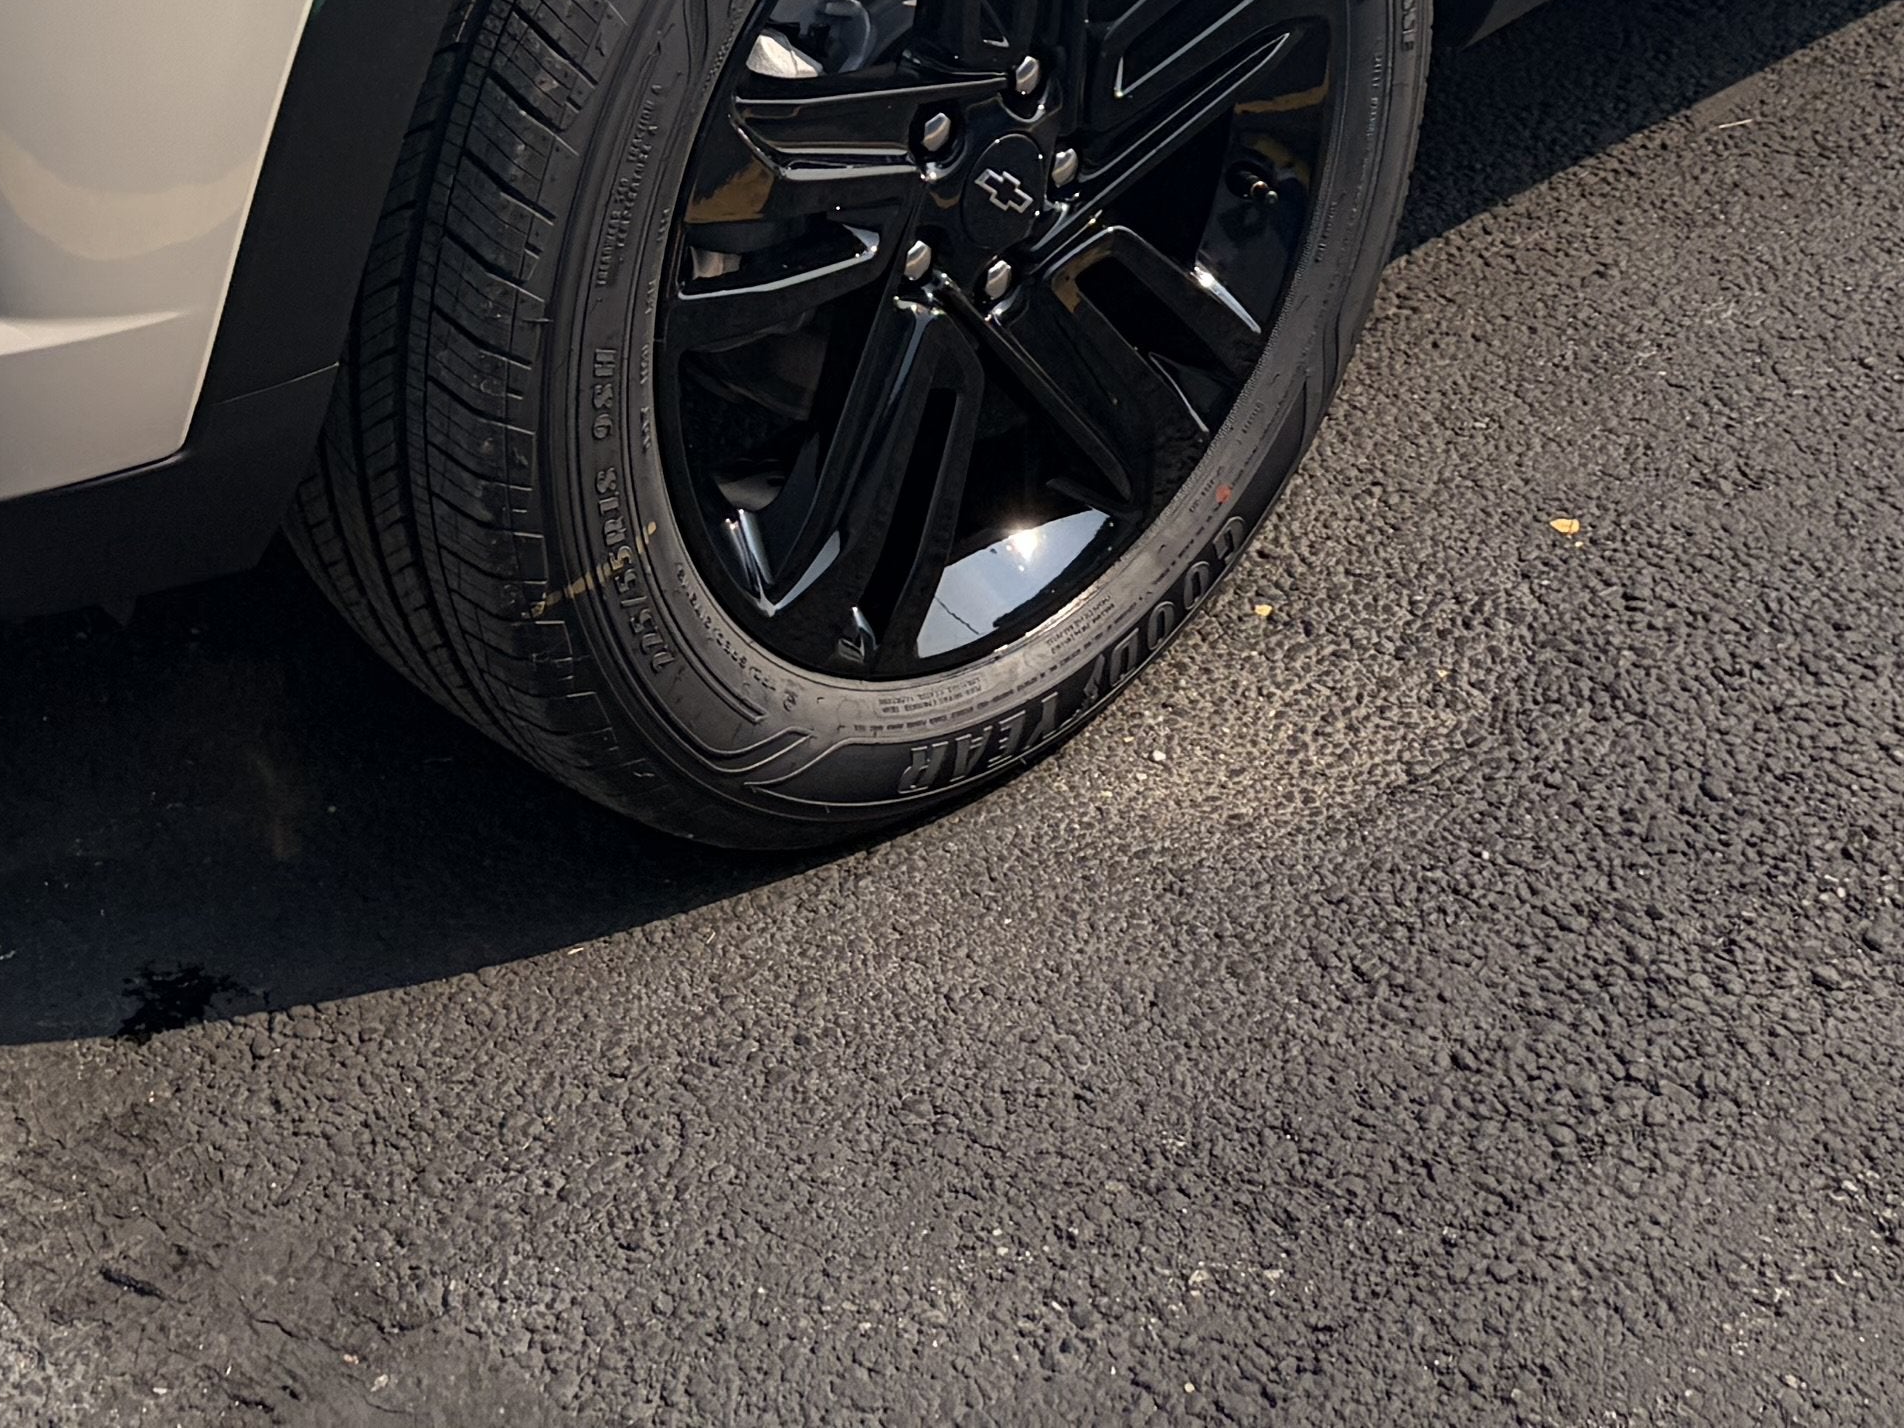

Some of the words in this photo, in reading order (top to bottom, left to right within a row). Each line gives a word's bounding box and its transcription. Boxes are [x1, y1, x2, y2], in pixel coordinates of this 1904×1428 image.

[593, 348, 617, 440] 98H
[595, 466, 677, 674] 225/55R18
[897, 515, 1247, 794] GOODYEAR
